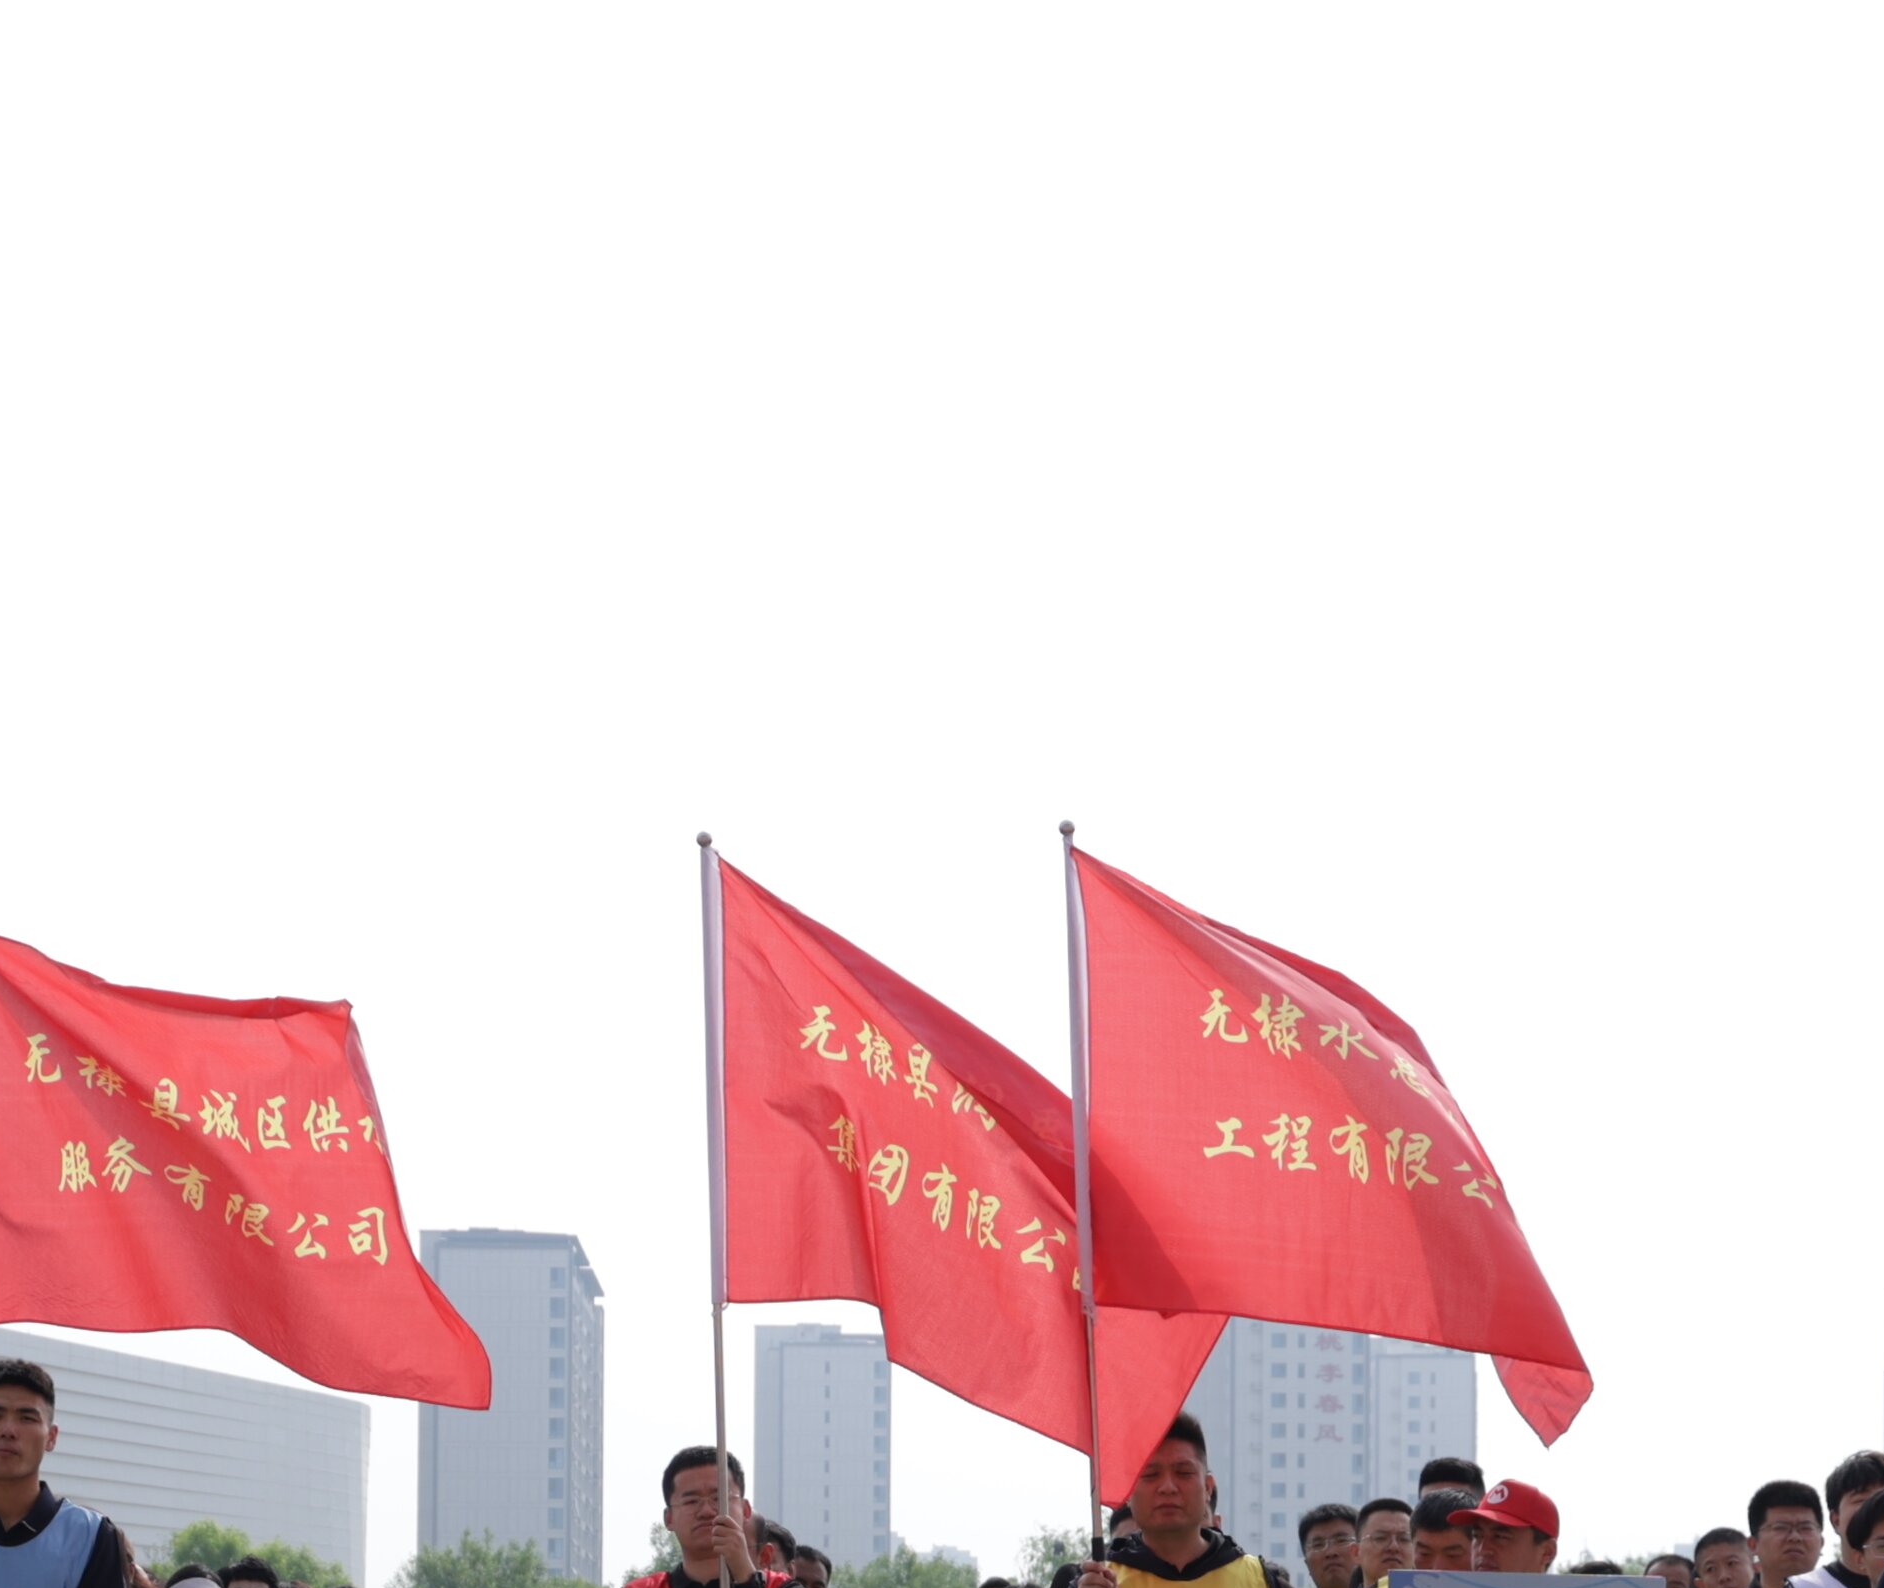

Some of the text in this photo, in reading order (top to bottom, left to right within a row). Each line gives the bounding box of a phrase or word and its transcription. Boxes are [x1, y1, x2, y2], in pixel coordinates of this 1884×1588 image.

[58, 1135, 391, 1266] 服务有限公司
[1314, 1331, 1346, 1444] 桃李春风
